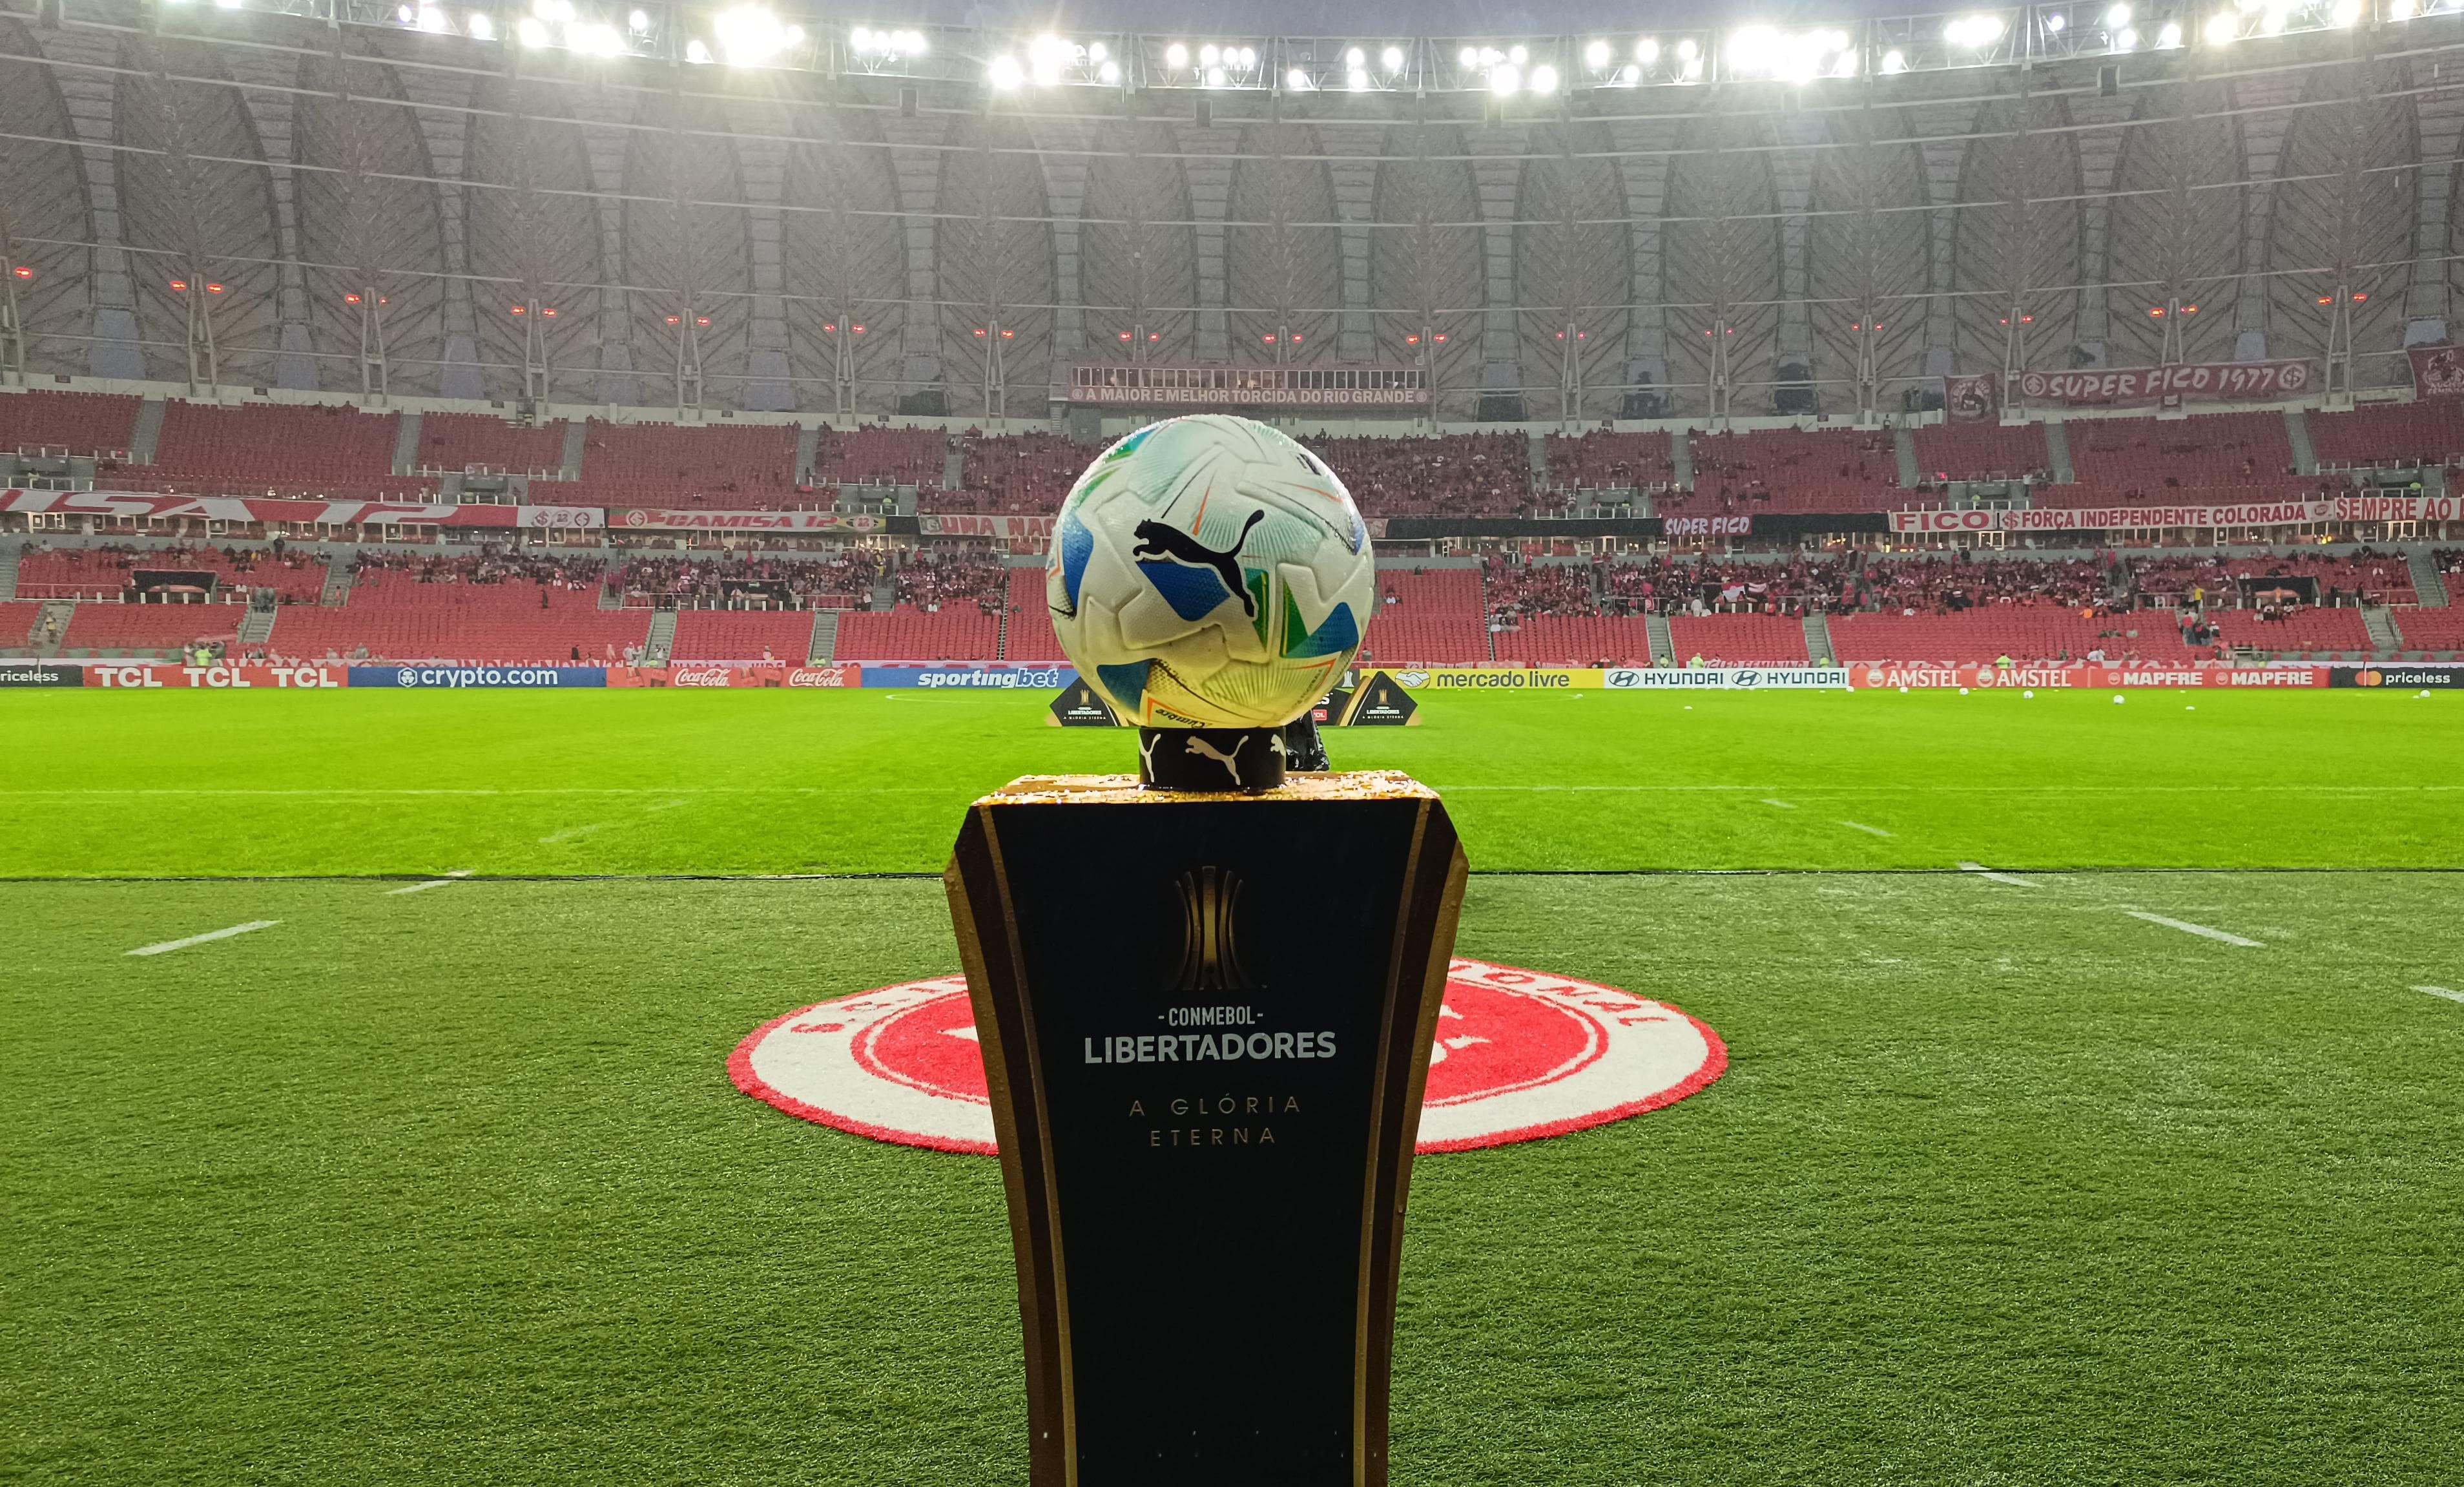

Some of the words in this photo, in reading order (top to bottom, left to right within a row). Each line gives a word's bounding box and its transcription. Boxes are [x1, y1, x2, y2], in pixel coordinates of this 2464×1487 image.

[2050, 374, 2137, 397] SUPER
[2146, 367, 2209, 393] FICO
[2219, 368, 2274, 392] 1977
[1086, 389, 1097, 400] A
[1101, 389, 1151, 401] MAIOR
[1154, 389, 1163, 401] E
[1166, 389, 1230, 402] MELHOR
[1232, 390, 1297, 402] TORCIDA
[1301, 390, 1321, 402] DO
[1325, 390, 1349, 402] RIO
[1352, 390, 1414, 403] GRANDE
[2022, 511, 2076, 531] FORÇA
[2080, 508, 2207, 528] INDEPENDENTE
[2213, 504, 2306, 523] COLORADA
[2336, 498, 2417, 521] SEMPRE
[2423, 498, 2452, 521] AO
[666, 515, 792, 528] CAMISA
[806, 516, 838, 528] 12
[940, 516, 996, 536] UMA
[1665, 517, 1708, 536] SUPER
[1712, 516, 1750, 534] FICO
[1897, 511, 1989, 531] FICO
[0, 670, 59, 681] riceless
[94, 667, 163, 687] TCL
[183, 667, 251, 687] TCL
[271, 667, 338, 687] TCL
[421, 667, 559, 687] crypto.com
[674, 668, 732, 687] Coca-Cola
[788, 668, 847, 687] Coca-Cola
[917, 668, 1059, 688] sportingbet
[1437, 671, 1524, 687] mercado
[1529, 671, 1570, 687] livre
[1645, 672, 1723, 685] HYUNDAI
[1767, 672, 1845, 685] HYUNDAI
[1886, 670, 1962, 687] AMSTEL
[1996, 670, 2072, 687] AMSTEL
[2123, 672, 2203, 685] MAPFRE
[2231, 671, 2313, 685] MAPFRE
[2386, 672, 2450, 685] priceless
[1084, 1031, 1336, 1064] LIBERTADORES
[1128, 1100, 1145, 1117] A
[1170, 1093, 1300, 1116] GLÓRIA
[1150, 1127, 1275, 1147] ETERNA
